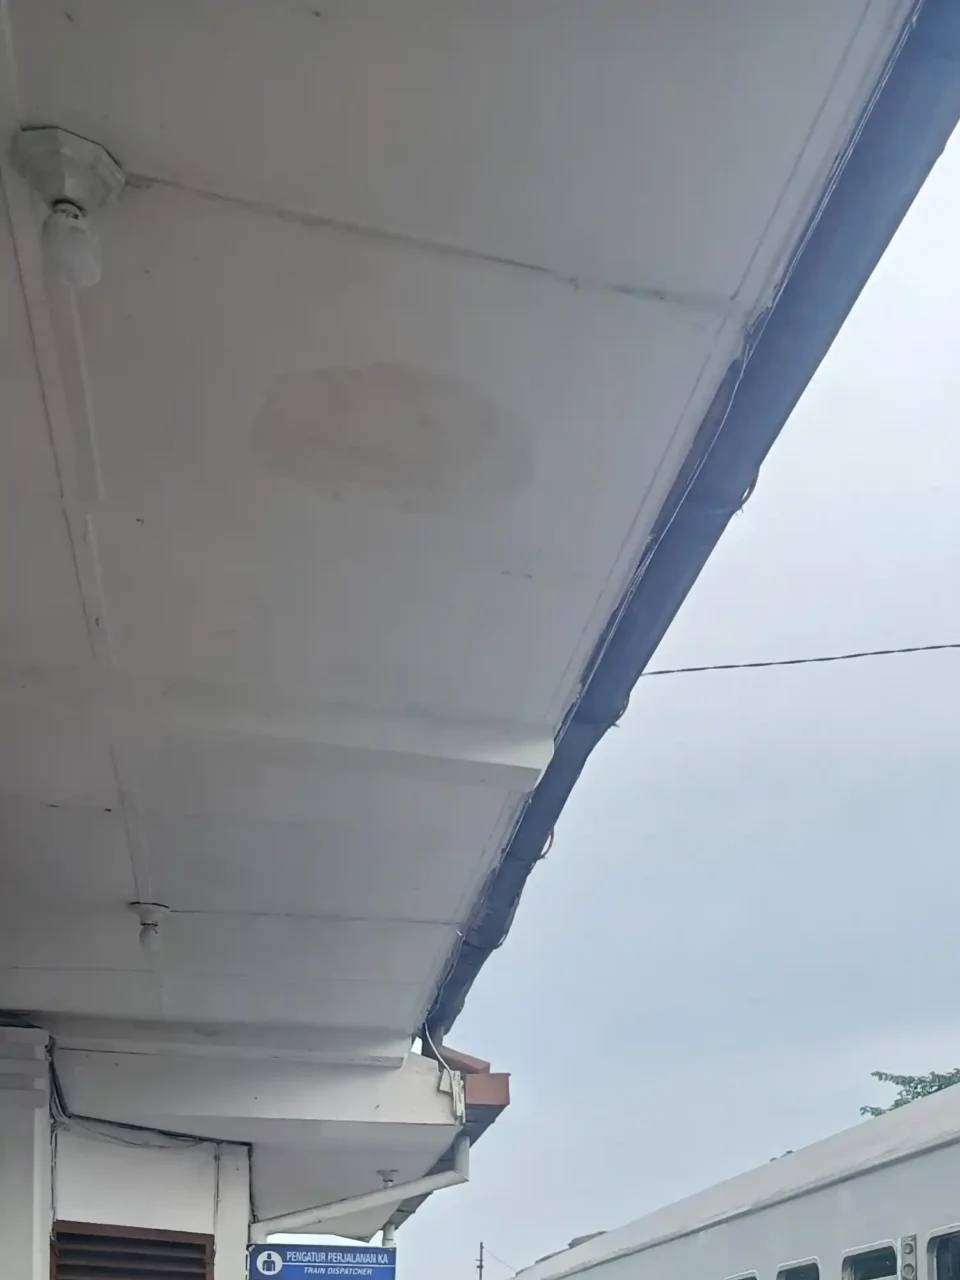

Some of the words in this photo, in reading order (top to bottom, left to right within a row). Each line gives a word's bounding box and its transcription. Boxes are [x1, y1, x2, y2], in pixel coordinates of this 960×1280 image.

[286, 1251, 325, 1263] PENGATUR
[327, 1252, 377, 1264] PERJALANAN
[378, 1253, 389, 1264] KA
[304, 1267, 325, 1275] TRAIN
[327, 1267, 373, 1275] DISPATCHER
